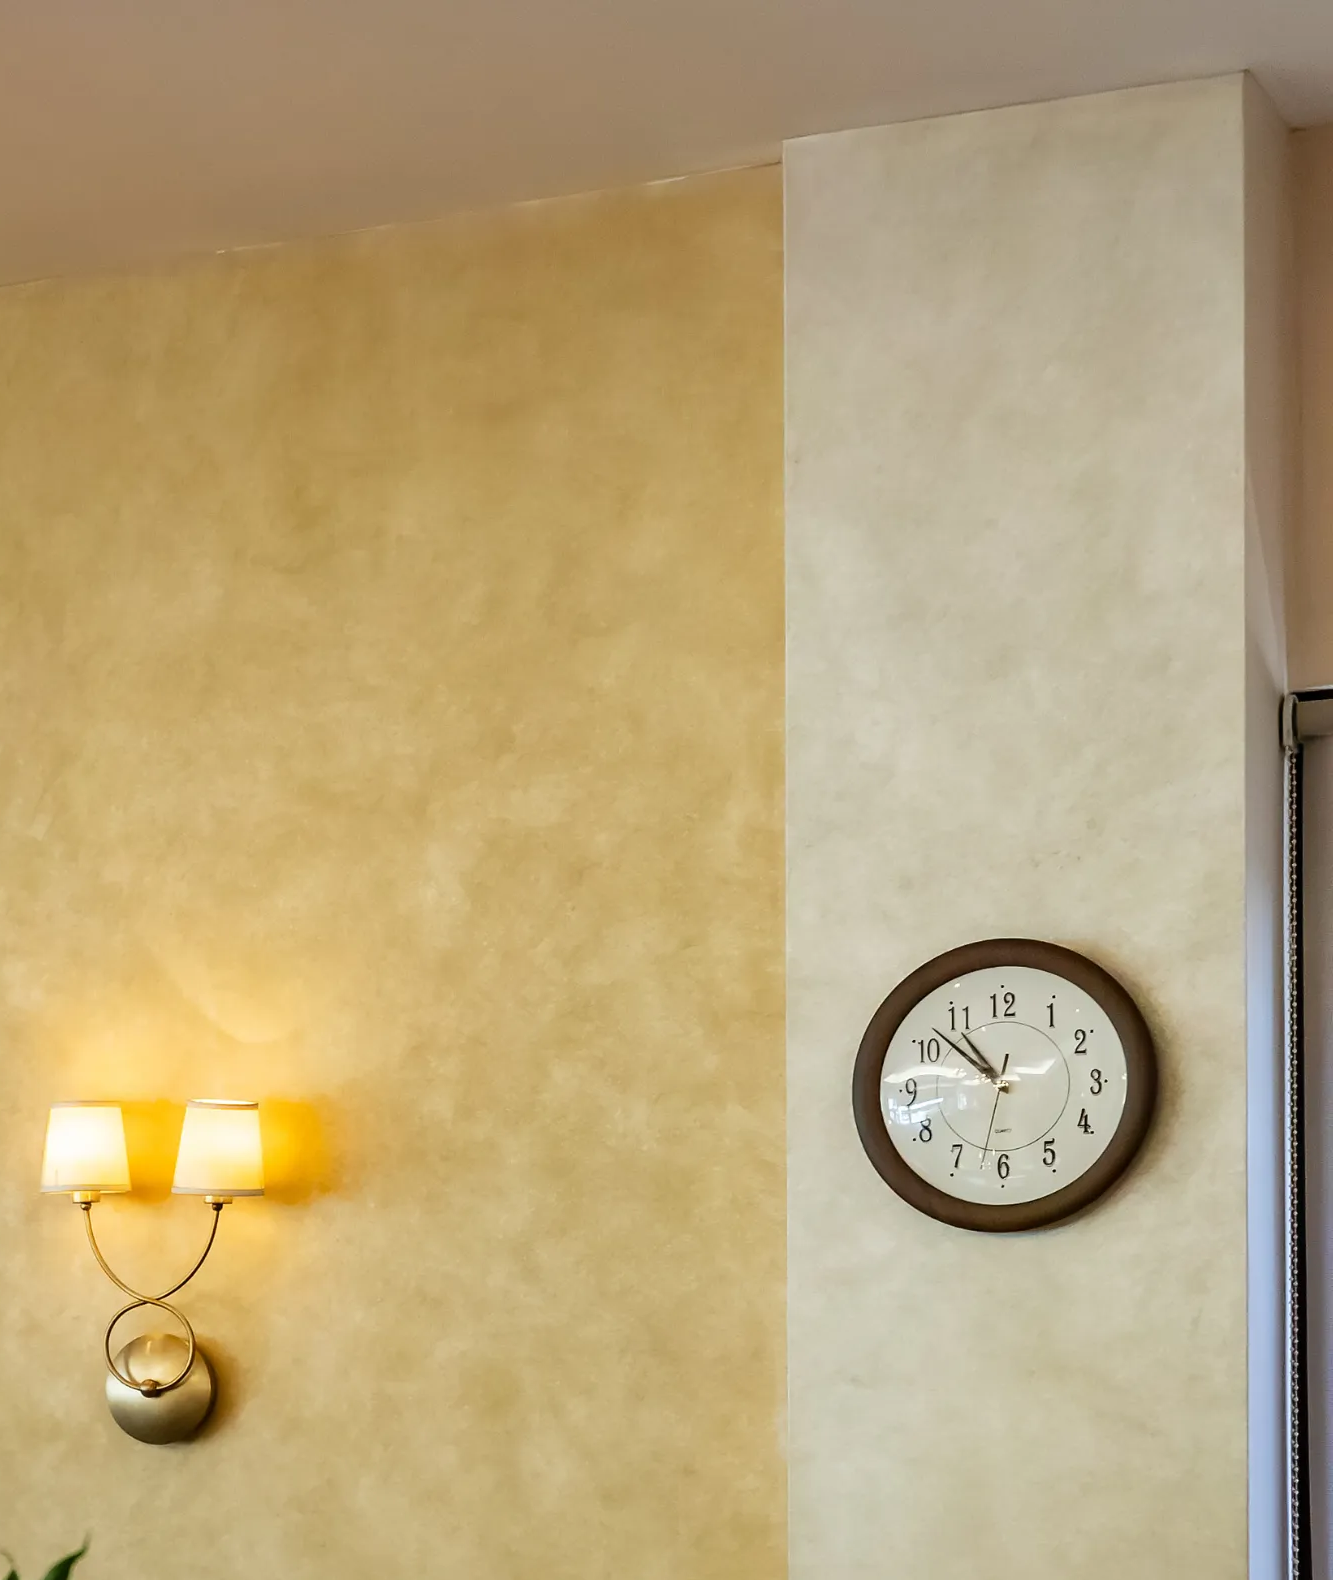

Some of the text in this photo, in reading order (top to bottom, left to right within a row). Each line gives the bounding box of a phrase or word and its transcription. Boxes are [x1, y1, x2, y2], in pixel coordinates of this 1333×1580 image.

[947, 1005, 971, 1031] 11
[989, 992, 1016, 1018] 12
[1046, 1003, 1055, 1028] 1
[917, 1037, 941, 1064] 10
[1073, 1028, 1088, 1055] 2
[904, 1077, 918, 1107] 9
[1089, 1068, 1103, 1095] 3
[918, 1118, 933, 1143] 8
[1077, 1108, 1092, 1133] 4
[949, 1143, 964, 1169] 7
[1042, 1137, 1057, 1167] 5
[997, 1153, 1010, 1180] 6
